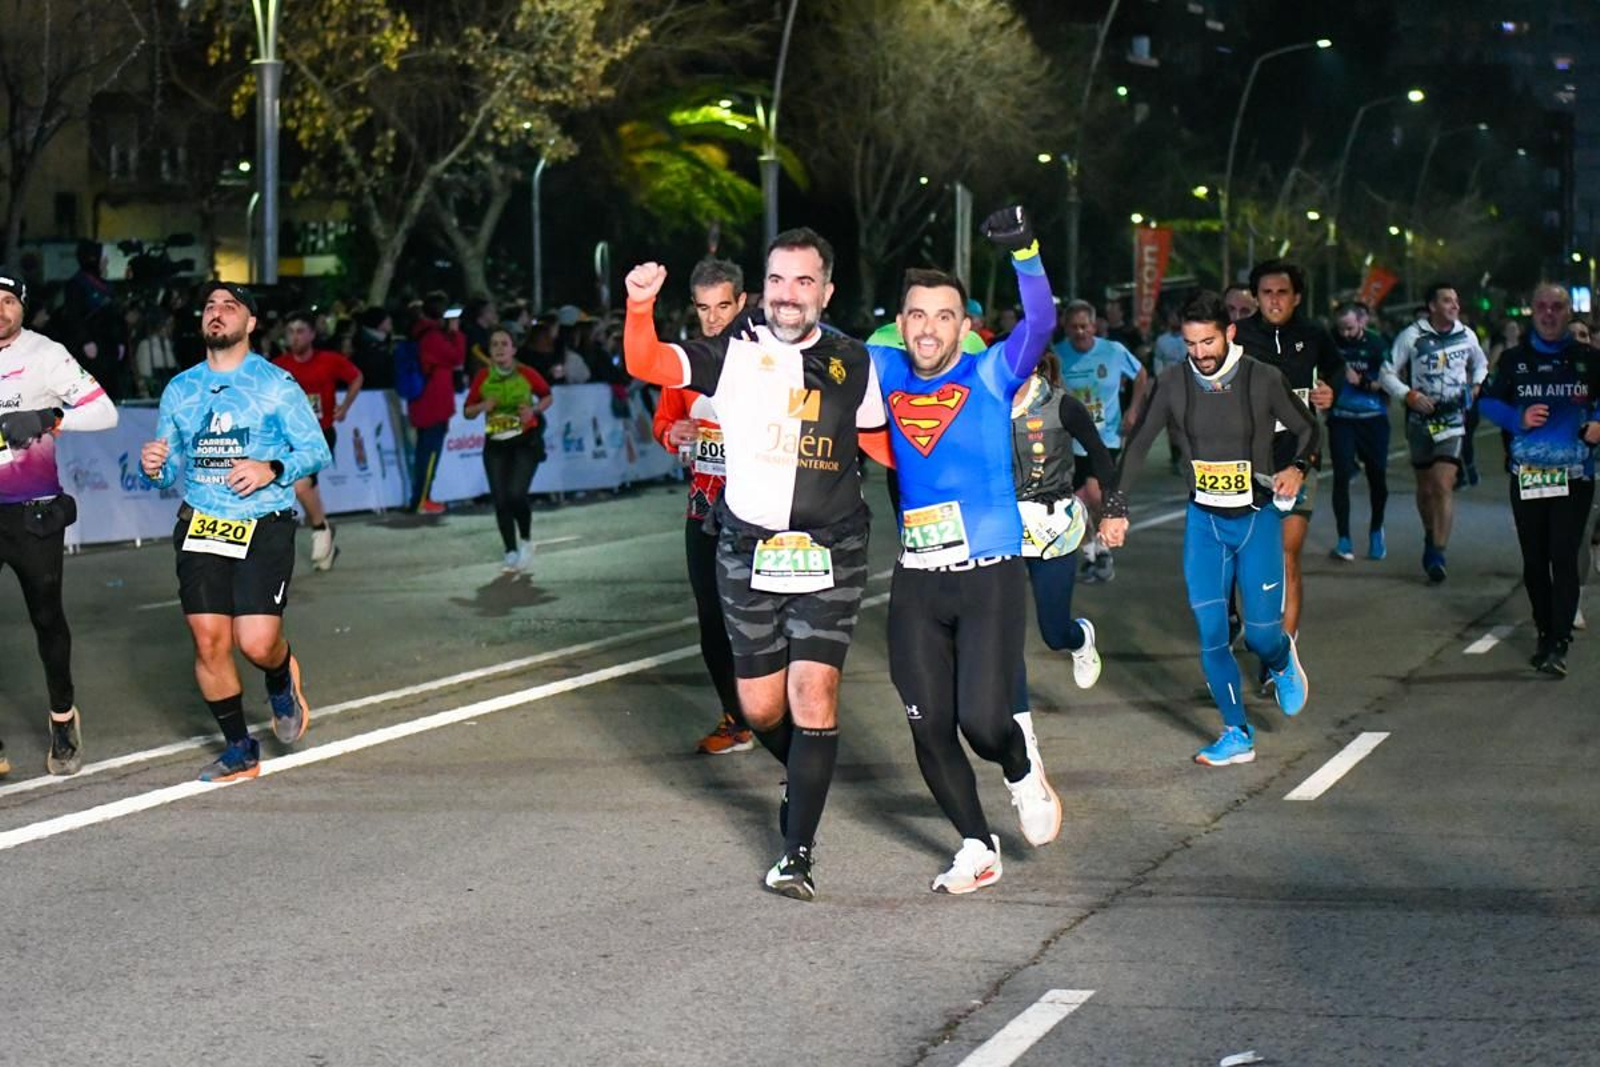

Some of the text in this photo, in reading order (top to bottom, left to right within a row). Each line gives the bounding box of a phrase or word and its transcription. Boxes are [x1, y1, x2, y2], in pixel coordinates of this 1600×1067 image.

[1516, 380, 1589, 397] SAN ANTÓN
[209, 411, 233, 435] 40
[198, 438, 240, 447] CARRERA
[766, 422, 834, 458] Jaén
[196, 446, 243, 455] POPULAR
[1198, 474, 1246, 490] 4238
[1522, 472, 1564, 487] 2417
[194, 519, 246, 540] 3420
[903, 519, 958, 549] 2132
[760, 548, 824, 571] 2218
